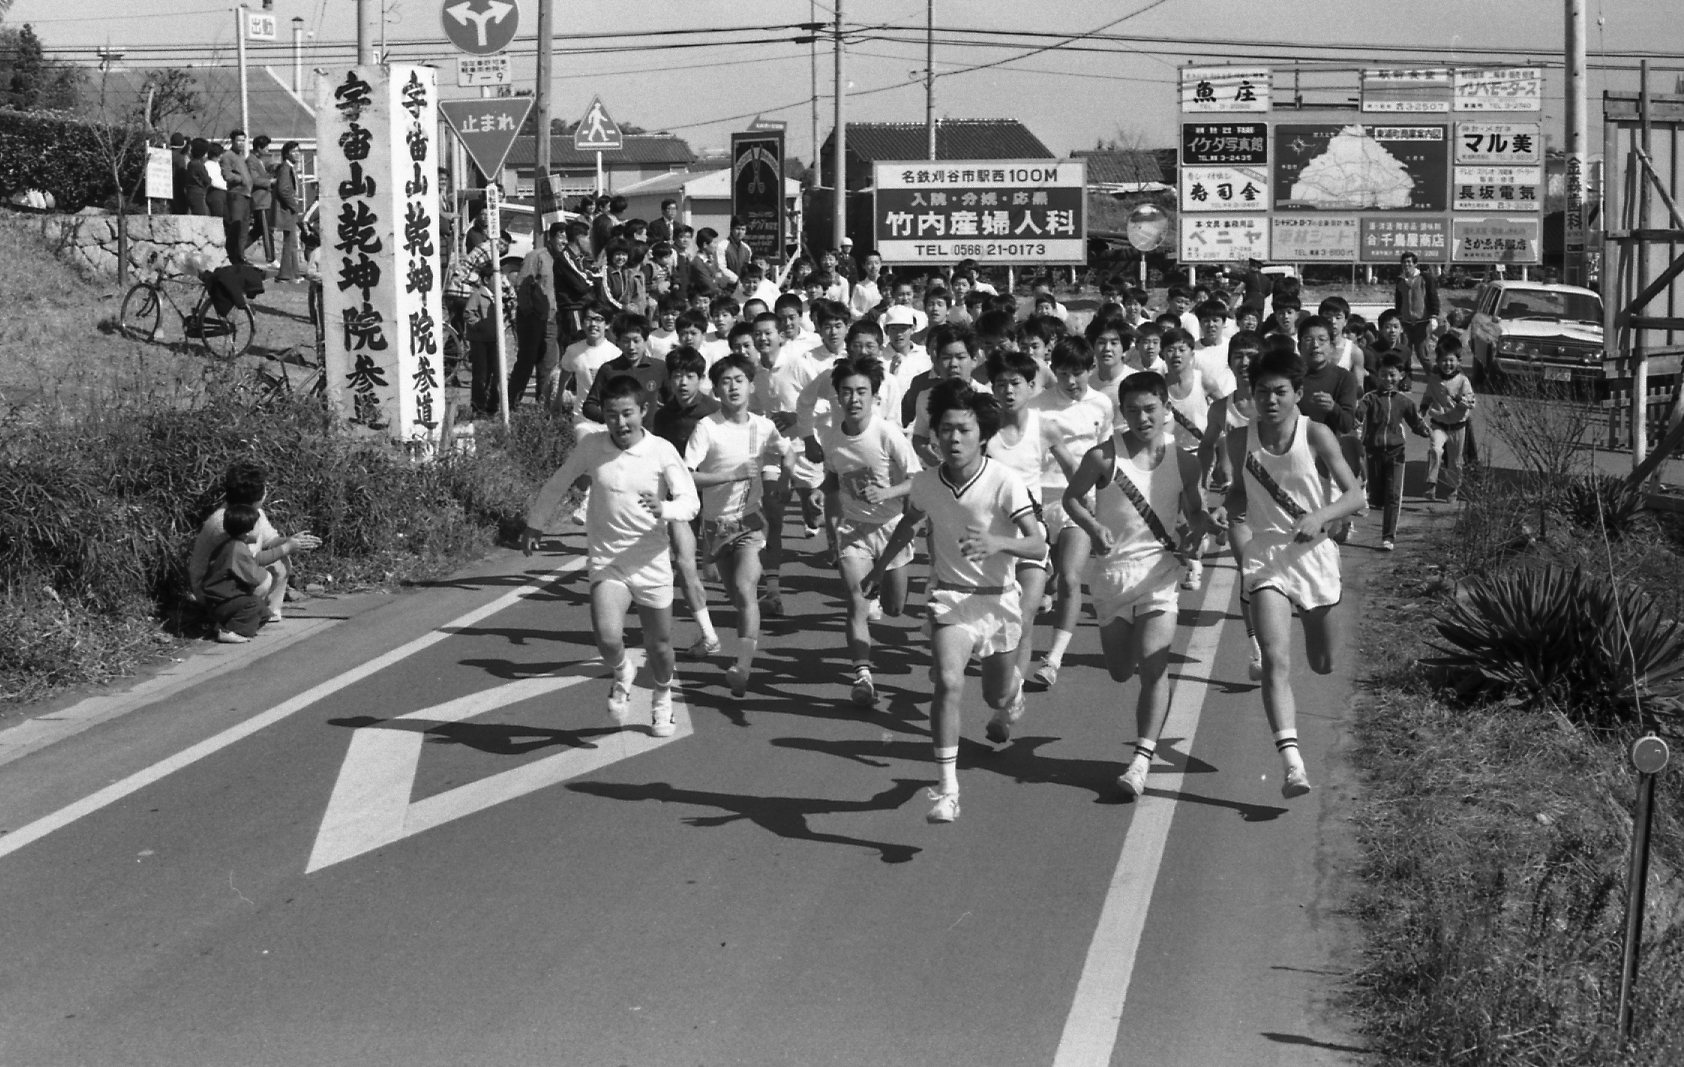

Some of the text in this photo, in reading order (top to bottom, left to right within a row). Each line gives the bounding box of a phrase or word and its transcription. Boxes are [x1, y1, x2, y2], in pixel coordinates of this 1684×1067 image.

[1193, 80, 1257, 103] 魚庄
[460, 112, 516, 133] 止まれ
[1187, 136, 1263, 152] イケダ写真館
[1464, 134, 1532, 152] マル美
[902, 168, 1058, 184] 名鉄刈谷市駅西100M
[1190, 182, 1261, 202] 寿司金
[1459, 186, 1536, 200] 長坂電気
[886, 210, 1076, 236] 竹内産婦人科
[1189, 230, 1262, 245] ベニヤ
[915, 244, 948, 256] TEL
